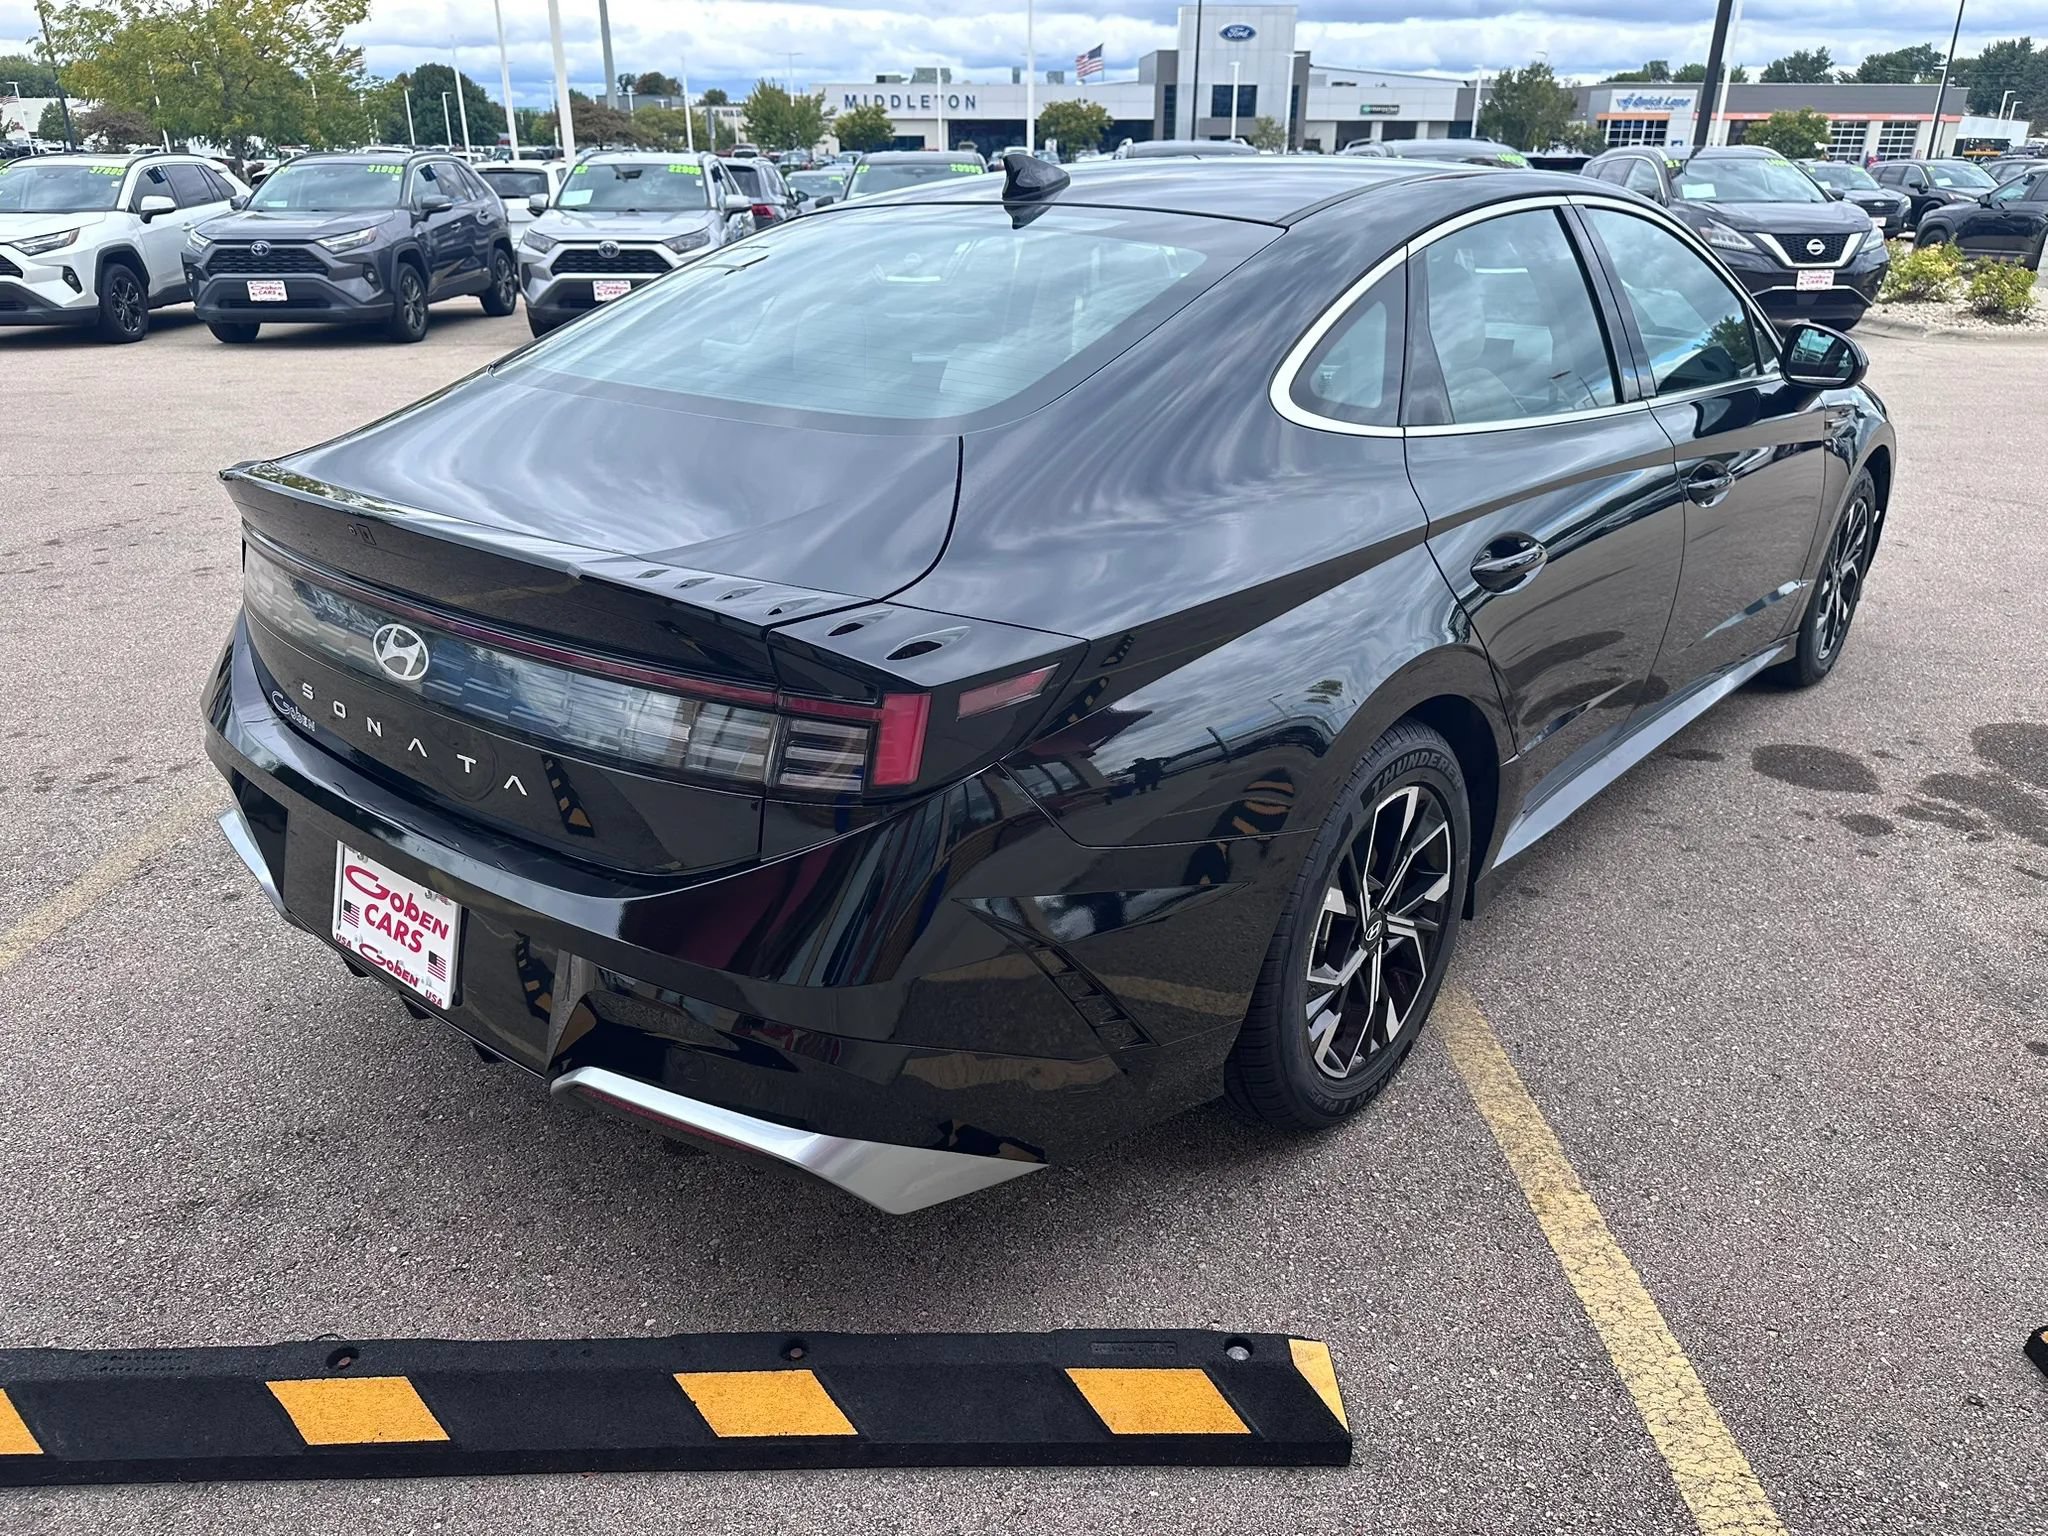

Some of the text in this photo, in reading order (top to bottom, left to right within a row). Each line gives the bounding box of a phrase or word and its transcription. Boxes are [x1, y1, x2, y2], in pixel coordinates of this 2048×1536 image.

[844, 94, 976, 110] MIDDLEON
[301, 681, 529, 796] SONATA
[364, 903, 425, 954] CARS
[335, 932, 353, 949] USA
[425, 988, 443, 1008] USA
